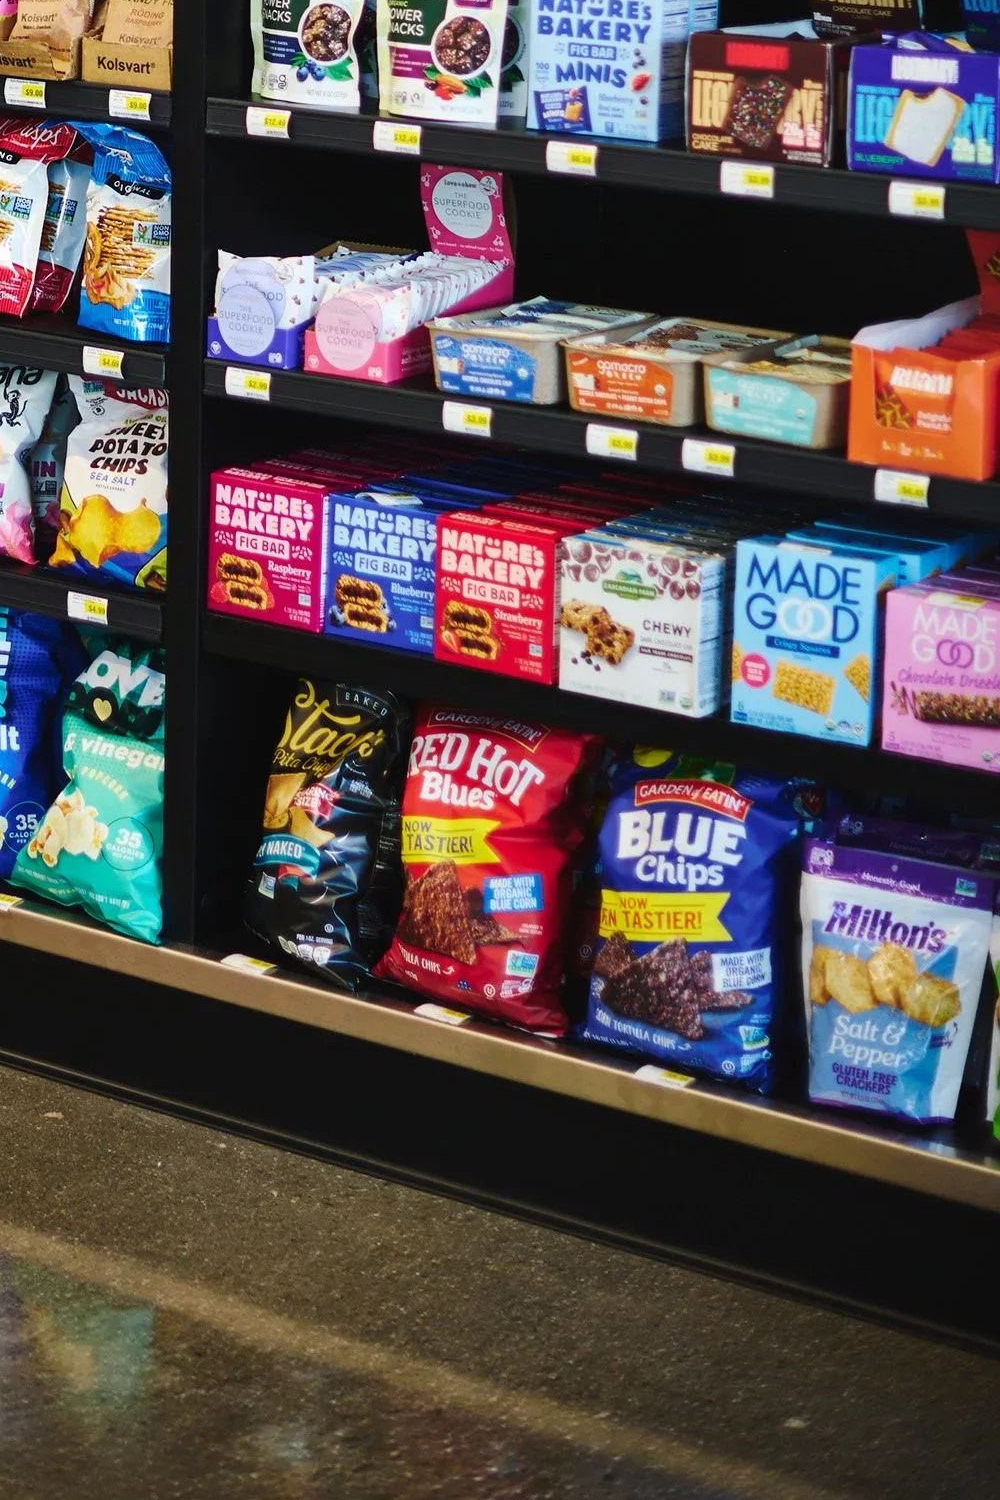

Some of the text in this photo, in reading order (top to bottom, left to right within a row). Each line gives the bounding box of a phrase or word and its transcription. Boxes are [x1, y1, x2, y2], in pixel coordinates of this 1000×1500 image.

[833, 5, 892, 18] CHOCOLATE CAKE
[537, 15, 651, 44] BAKERY
[570, 44, 615, 59] FIG BAR
[556, 62, 627, 88] MINIS
[26, 88, 42, 98] $9.00
[264, 116, 286, 126] $12.49
[433, 197, 490, 211] SUPERFOOD
[445, 208, 481, 219] COOKIE
[88, 440, 167, 455] POTATO
[89, 456, 148, 474] CHIPS
[90, 471, 137, 487] SEA SALT
[215, 504, 313, 541] BAKERY
[240, 534, 285, 556] FIG BAR
[334, 525, 436, 562] BAKERY
[268, 560, 311, 580] Raspberry
[359, 557, 407, 577] FIG BAR
[441, 550, 544, 589] BAKERY
[747, 551, 862, 606] MADE
[391, 582, 434, 602] Blueberry
[468, 582, 515, 604] FIG BAR
[494, 608, 542, 629] Strawberry
[746, 592, 859, 643] GOOD
[912, 608, 997, 642] MADE
[643, 619, 692, 638] CHEWY
[912, 635, 998, 673] GOOD
[345, 692, 388, 718] BAKED
[434, 711, 543, 742] GARDEN EATIN'
[272, 748, 301, 768] Pita
[407, 732, 545, 807] RED HOT
[419, 771, 496, 811] Blues
[639, 781, 744, 811] GARDEN EATIN'
[15, 814, 38, 830] 35
[404, 822, 432, 833] NOW
[118, 828, 141, 846] 35
[407, 834, 474, 854] TASTIER!
[617, 810, 748, 866] BLUE
[490, 878, 535, 888] MADE WITH
[635, 857, 724, 892] Chips
[490, 898, 537, 909] BLUE CORN
[493, 888, 532, 898] ORGANIC
[619, 898, 648, 910] NOW
[624, 909, 702, 929] TASTIER!
[824, 900, 949, 954] Milton's
[833, 1016, 877, 1041] Salt
[828, 1034, 902, 1068] Pepper
[832, 1062, 898, 1087] GLUTEN FREE
[836, 1073, 891, 1096] CRACKERS
